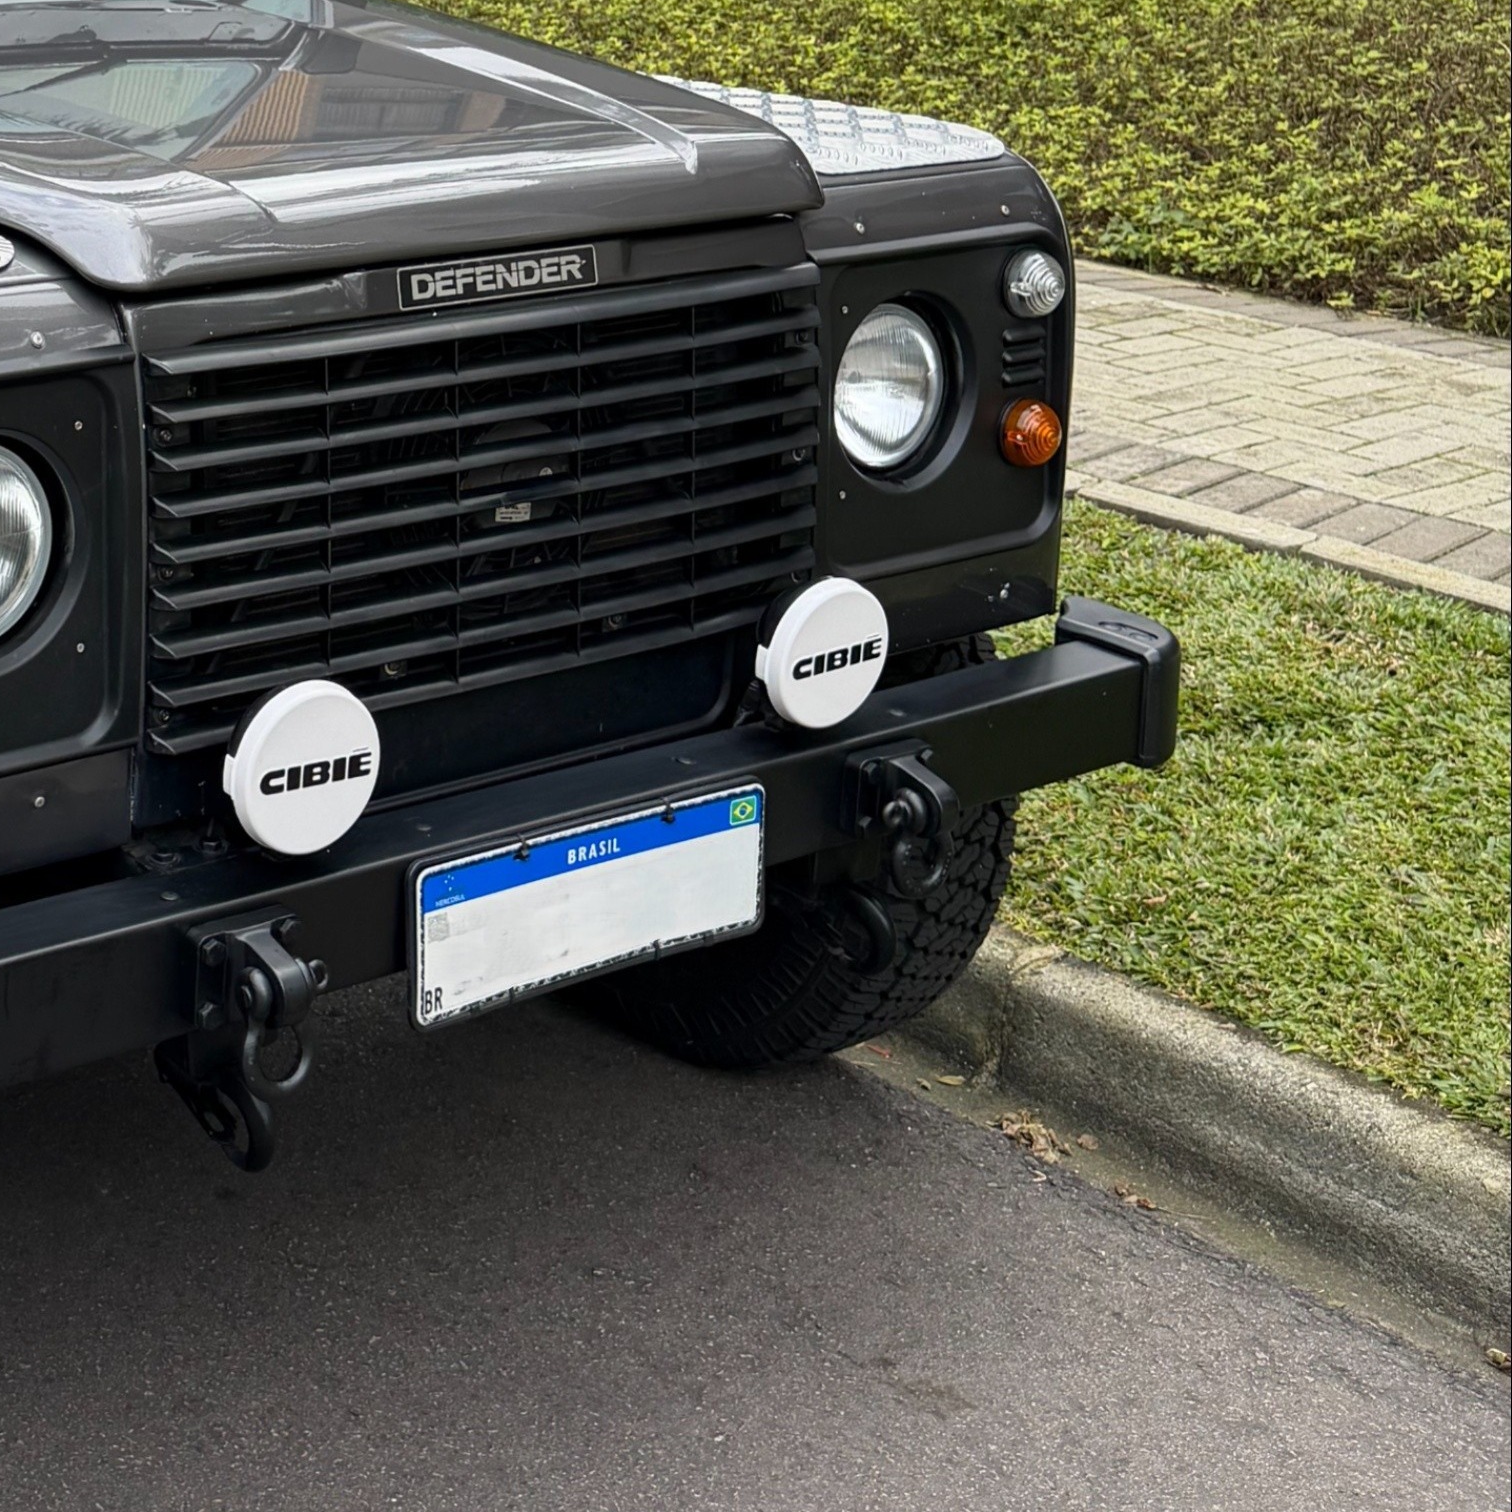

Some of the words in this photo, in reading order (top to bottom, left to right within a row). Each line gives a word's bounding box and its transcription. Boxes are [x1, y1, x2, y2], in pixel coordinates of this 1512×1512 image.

[410, 253, 585, 301] DEFENDER
[566, 837, 622, 866] BRASIL
[424, 986, 443, 1016] BR
